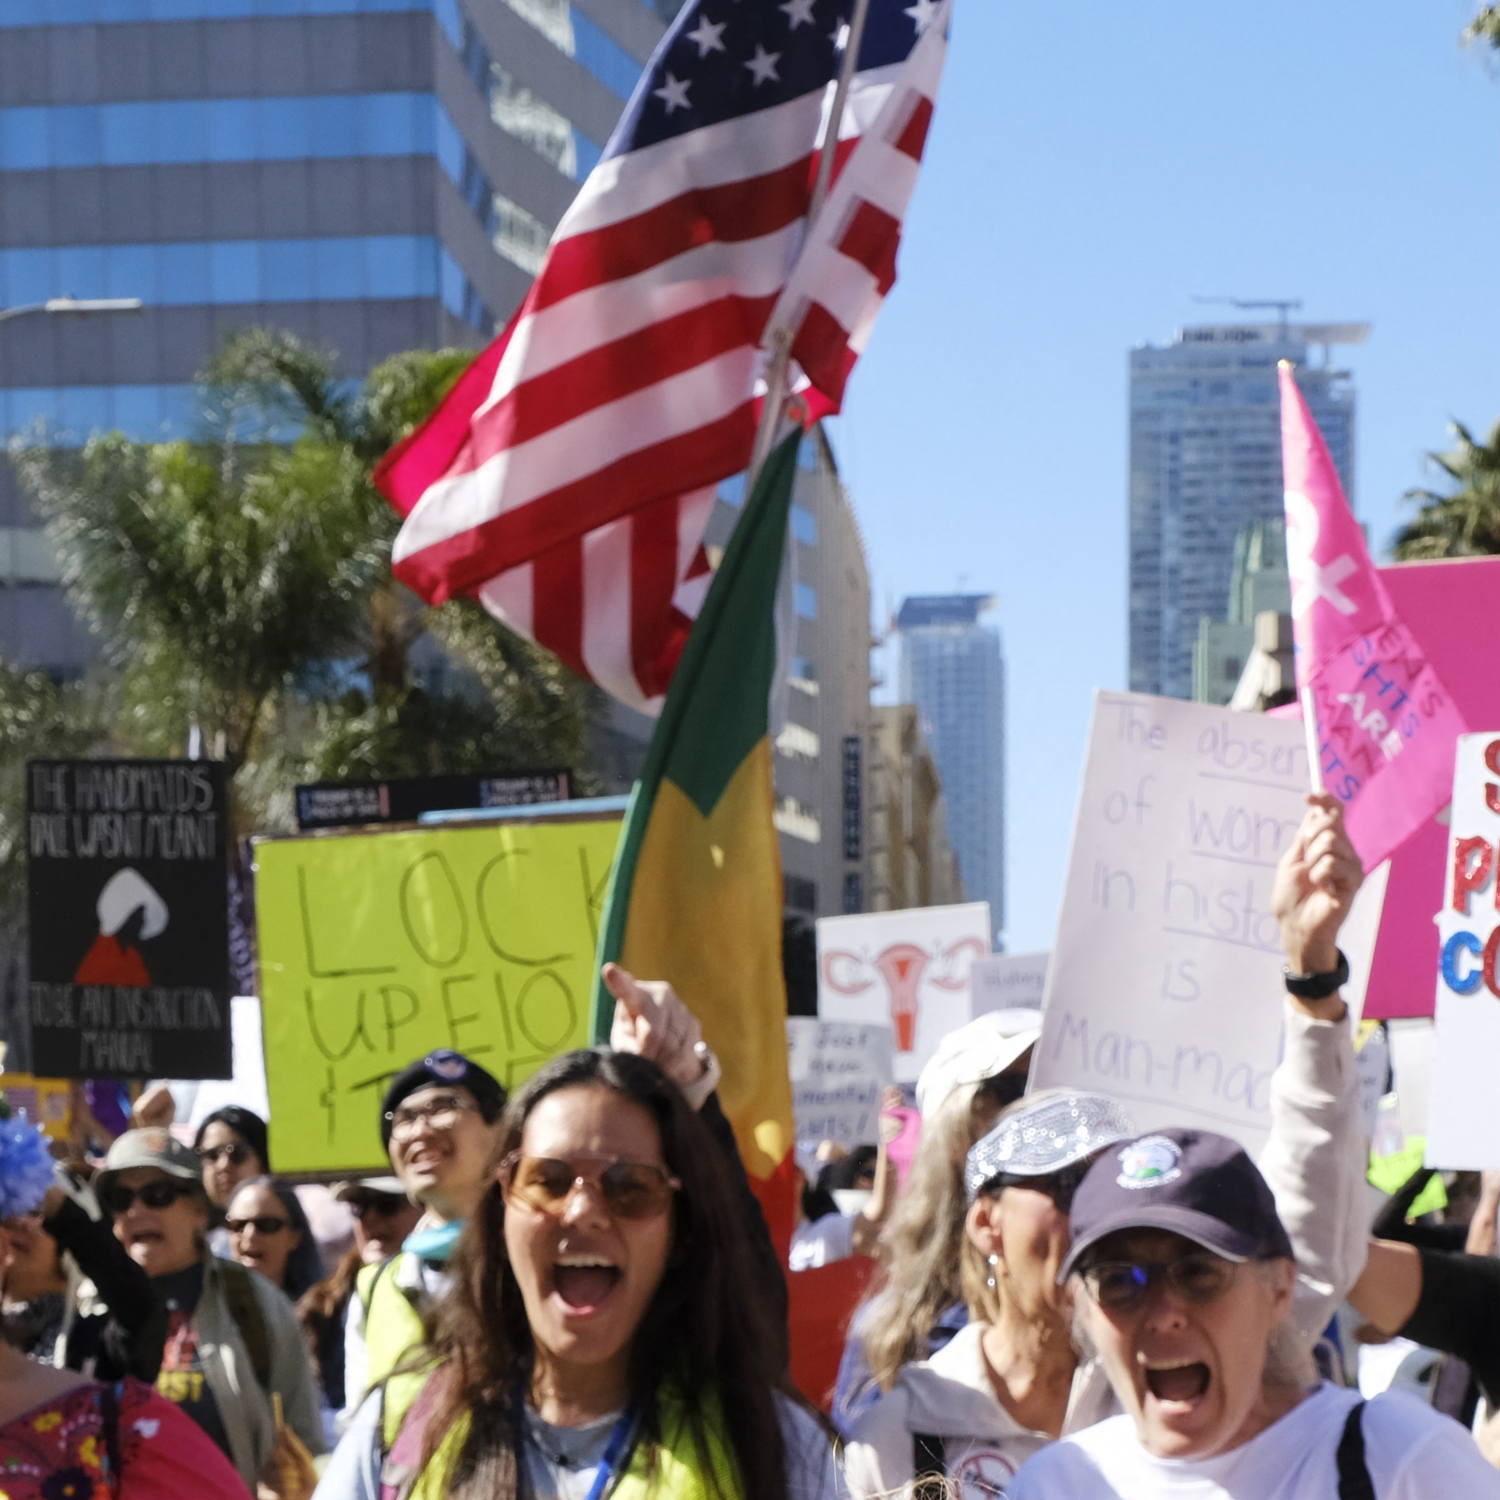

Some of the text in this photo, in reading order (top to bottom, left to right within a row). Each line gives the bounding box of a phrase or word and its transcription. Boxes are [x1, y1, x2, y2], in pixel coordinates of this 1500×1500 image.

[1198, 721, 1312, 776] absen
[1336, 691, 1403, 761] ARE
[1103, 773, 1300, 858] of wom
[1164, 860, 1281, 946] histo
[1053, 1011, 1286, 1115] Man-mad
